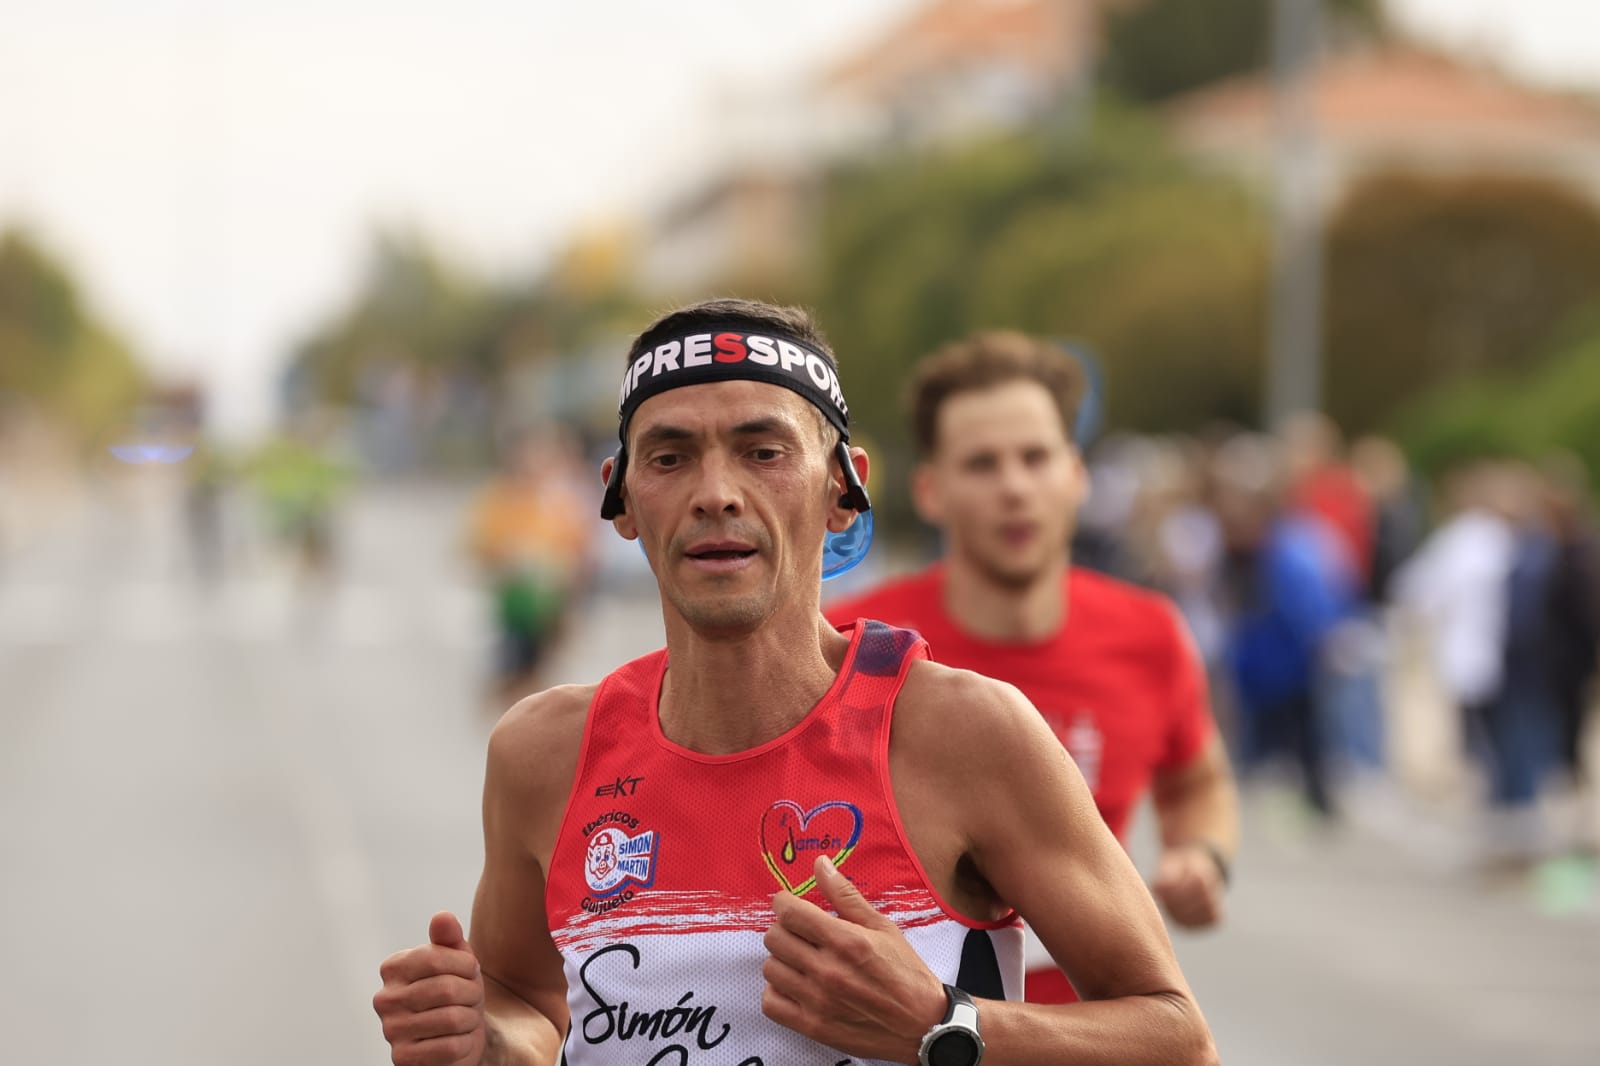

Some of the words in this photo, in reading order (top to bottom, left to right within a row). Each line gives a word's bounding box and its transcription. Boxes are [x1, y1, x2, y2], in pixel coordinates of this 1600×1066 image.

[595, 776, 645, 798] EKT
[618, 834, 652, 855] SIMON
[617, 857, 649, 877] MARTIN
[581, 890, 634, 915] Guijuelo
[579, 943, 731, 1050] Simón
